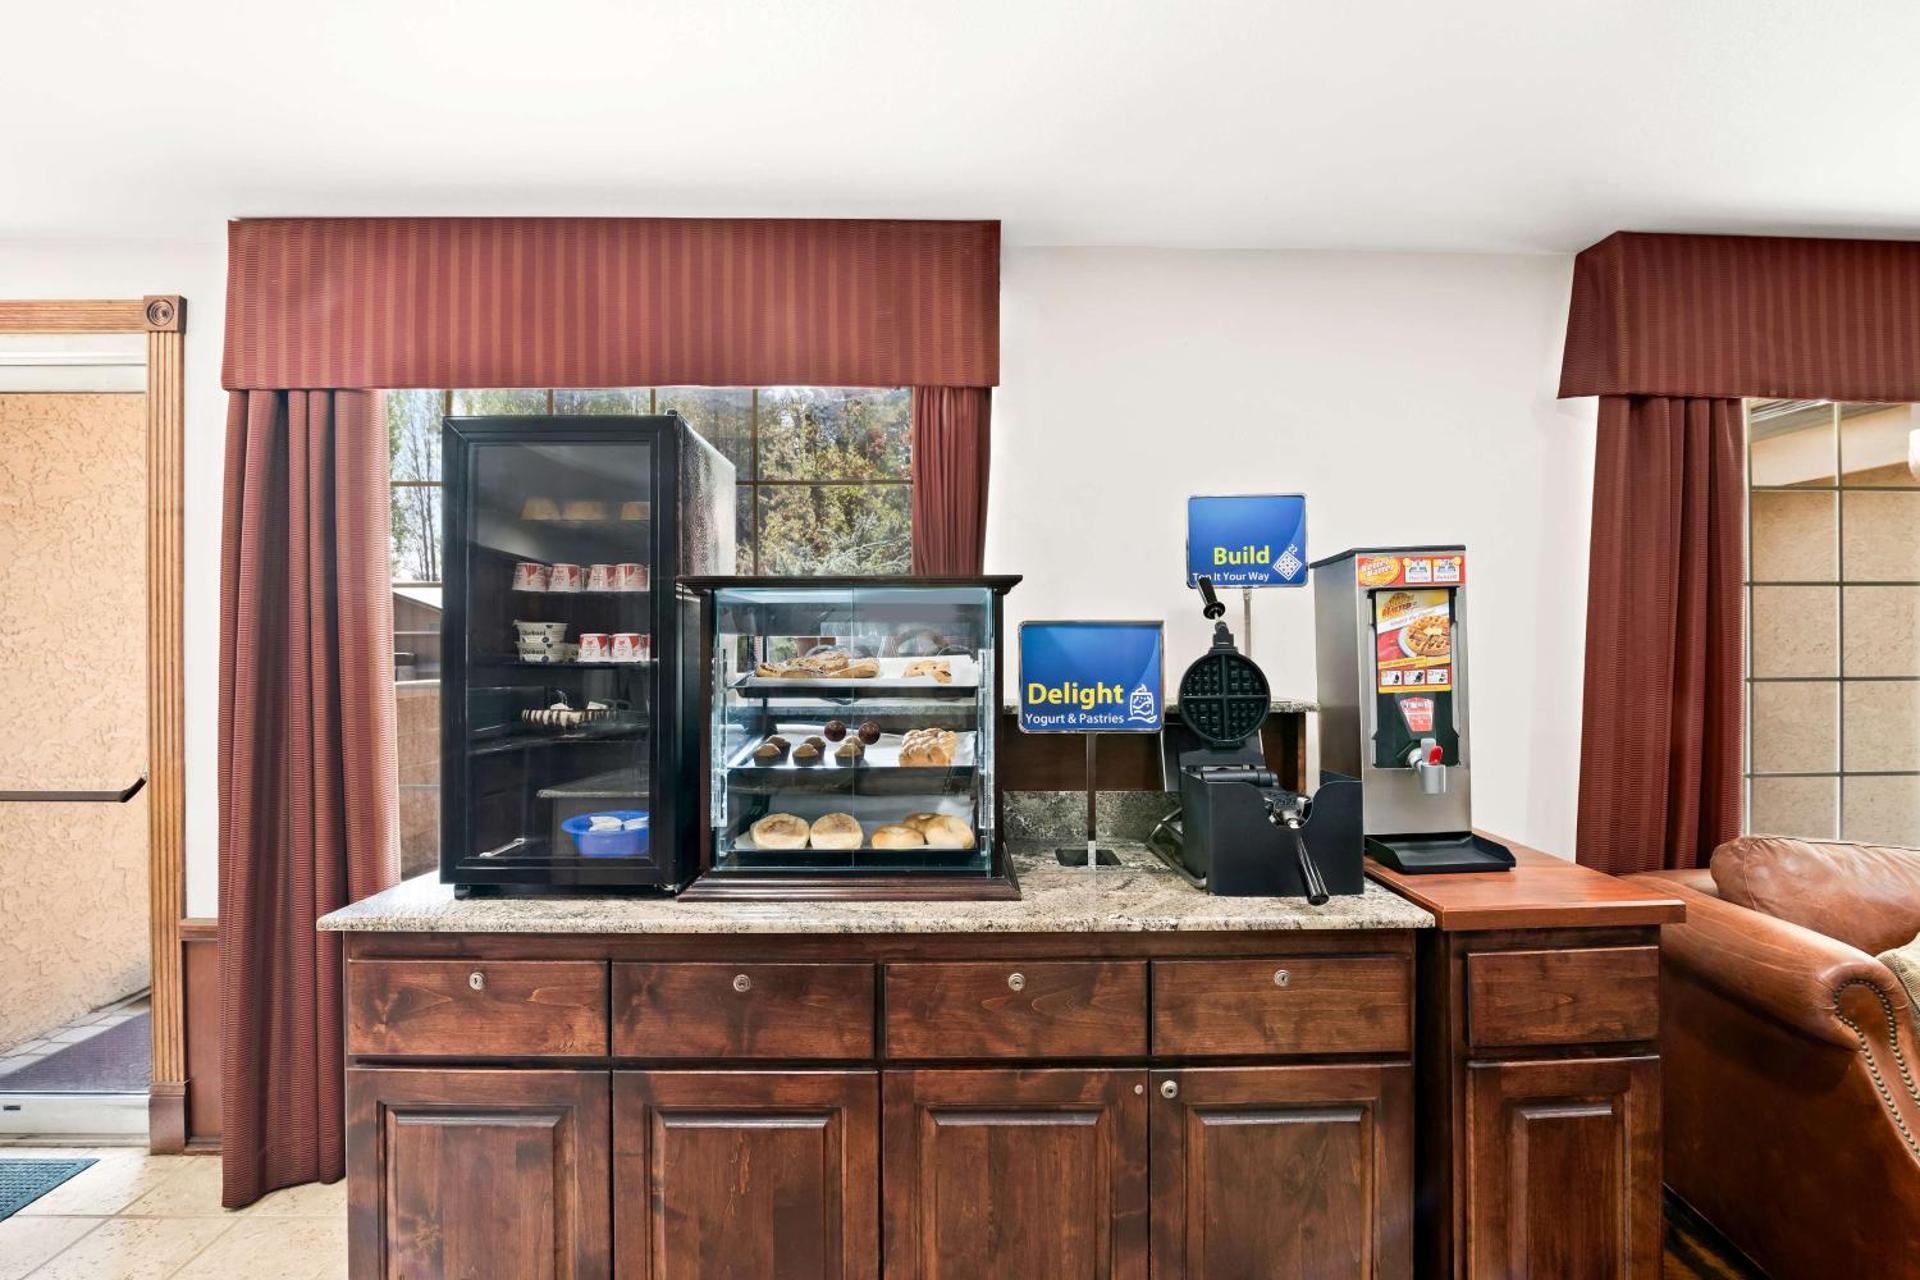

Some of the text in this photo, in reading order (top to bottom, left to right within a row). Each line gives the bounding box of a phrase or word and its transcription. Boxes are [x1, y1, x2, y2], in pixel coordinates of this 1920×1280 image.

[1213, 545, 1270, 565] Build
[1214, 573, 1221, 581] It
[1222, 572, 1247, 581] Your
[1248, 573, 1270, 582] Way
[1028, 682, 1124, 710] Delight
[1025, 713, 1125, 726] Yogurt & Pastries
